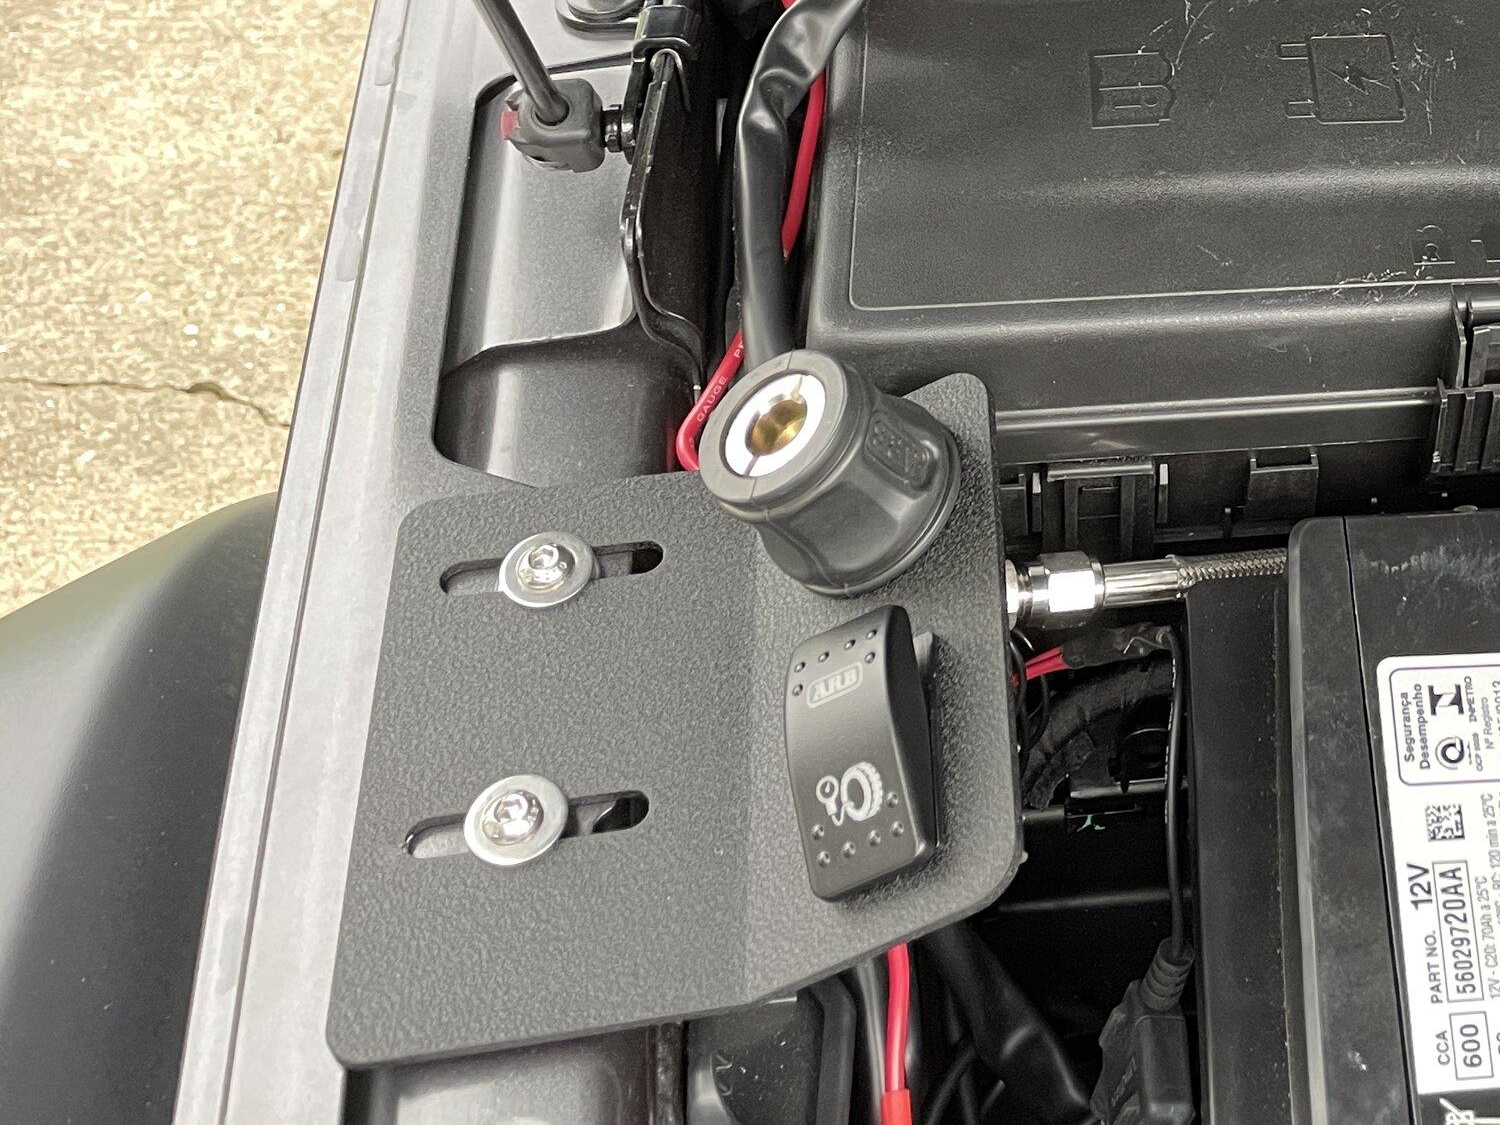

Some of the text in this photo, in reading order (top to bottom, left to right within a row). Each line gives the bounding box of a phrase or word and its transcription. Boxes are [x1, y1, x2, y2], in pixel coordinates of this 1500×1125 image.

[696, 375, 728, 423] GAUGE
[812, 666, 858, 702] ARB
[1397, 691, 1416, 762] Segurança
[1410, 682, 1431, 769] Desempenho
[1478, 695, 1494, 735] Registro
[1406, 862, 1433, 910] 12V
[1438, 866, 1476, 994] 56029720AA
[1423, 929, 1443, 1004] PART NO.
[1434, 1029, 1451, 1065] CCA
[1458, 1022, 1483, 1068] 600
